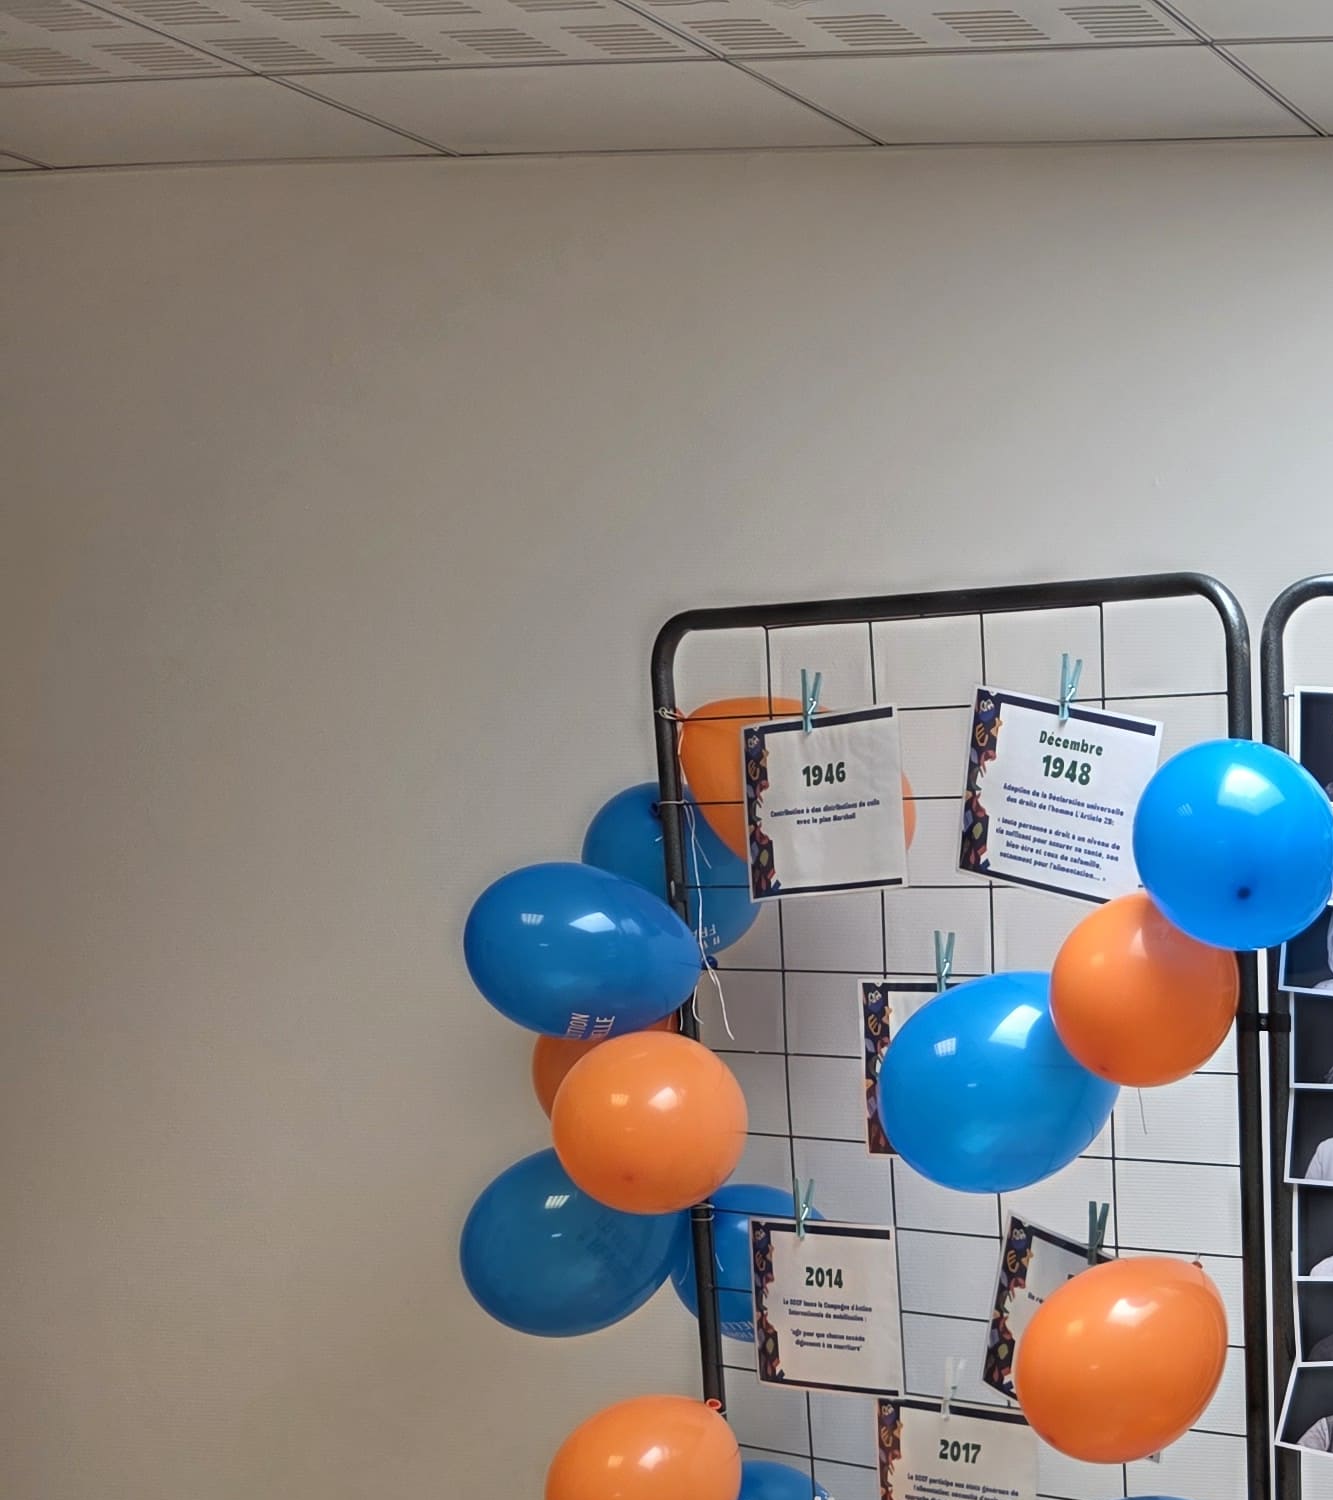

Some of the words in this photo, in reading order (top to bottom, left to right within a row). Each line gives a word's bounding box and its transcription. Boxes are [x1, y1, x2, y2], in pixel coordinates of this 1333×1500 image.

[1039, 730, 1104, 756] Décembre
[802, 761, 847, 788] 1946
[1041, 754, 1092, 786] 1948
[805, 1267, 843, 1289] 2014
[939, 1439, 981, 1465] 2017
